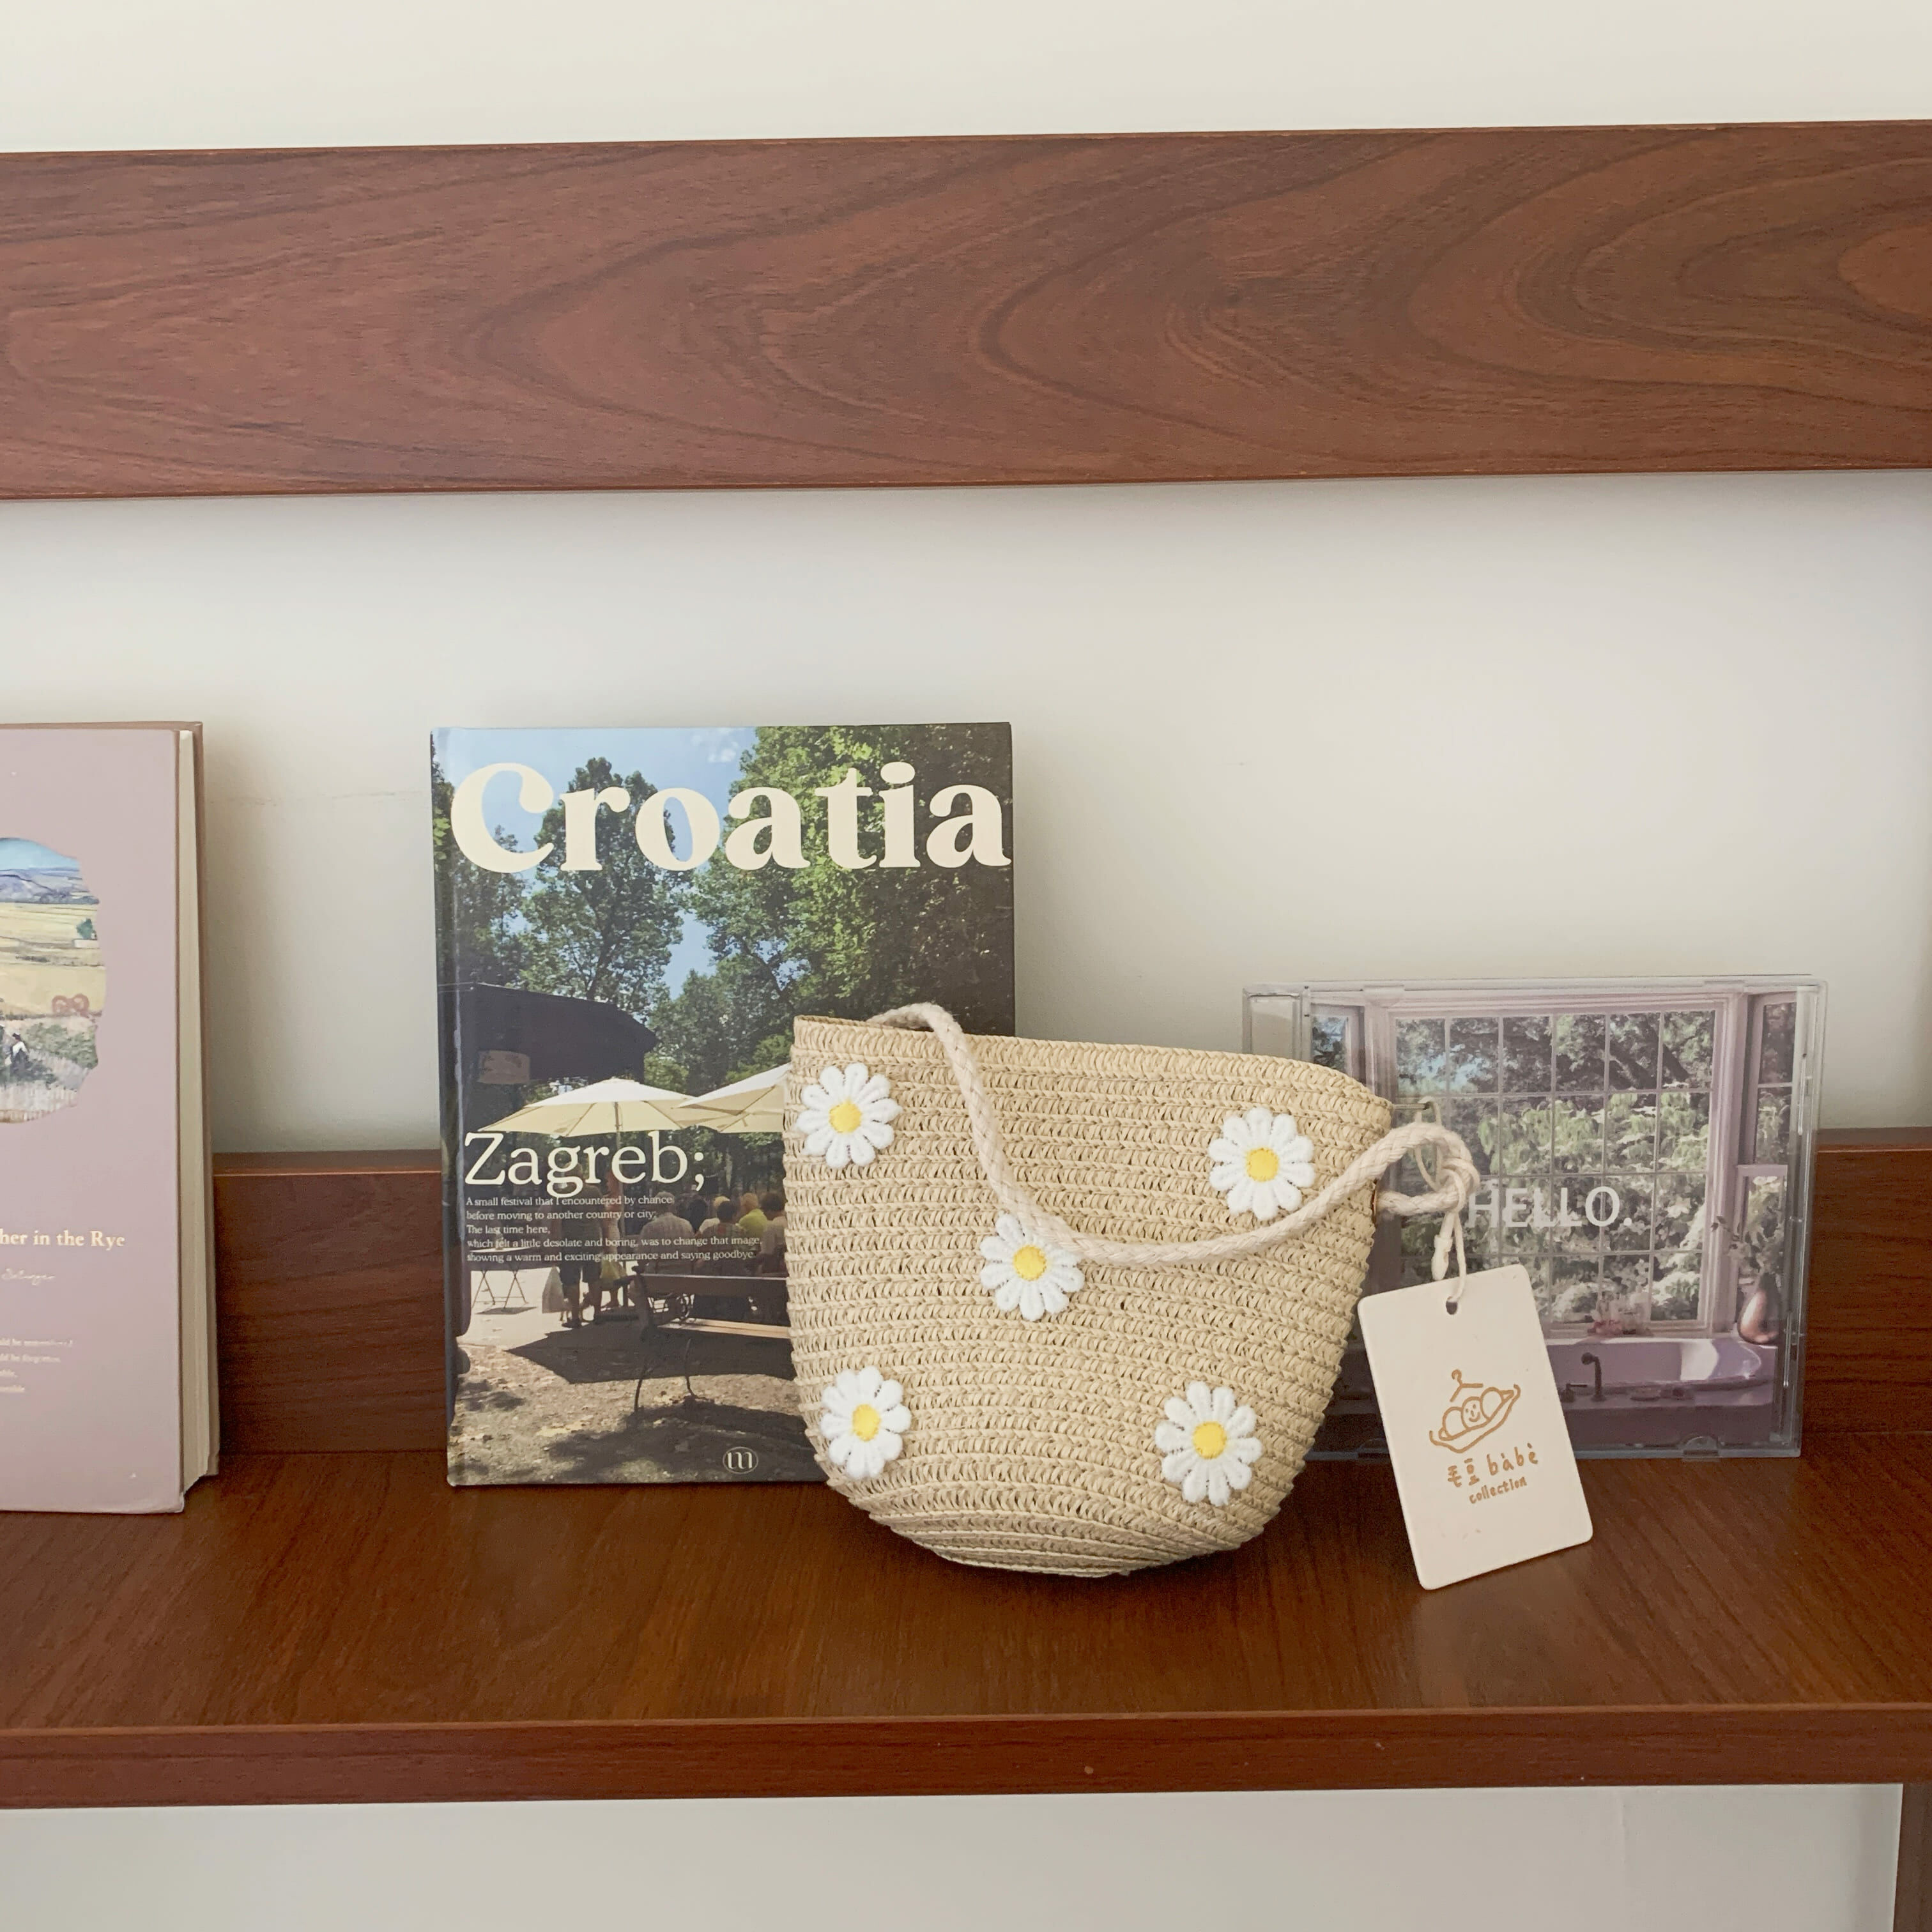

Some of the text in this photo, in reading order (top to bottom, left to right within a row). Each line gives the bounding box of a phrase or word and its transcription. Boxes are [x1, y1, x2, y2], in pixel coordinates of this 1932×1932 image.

[450, 762, 1012, 874] Croatia
[464, 1130, 705, 1199] Zagreb;
[466, 1197, 473, 1206] A
[474, 1197, 498, 1206] small
[501, 1197, 532, 1206] festival
[535, 1197, 553, 1206] that
[562, 1196, 622, 1206] encountered
[624, 1195, 636, 1206] by
[638, 1195, 673, 1204] chance
[1468, 1186, 1632, 1228] HELLO.
[466, 1211, 494, 1220] before
[497, 1211, 532, 1222] moving
[535, 1211, 544, 1220] to
[547, 1211, 583, 1220] another
[586, 1211, 621, 1221] country
[466, 1224, 482, 1234] The
[486, 1225, 501, 1234] last
[503, 1225, 525, 1234] time
[33, 1230, 50, 1245] in
[56, 1230, 84, 1246] the
[91, 1230, 126, 1251] Rye
[467, 1239, 493, 1248] which
[495, 1239, 510, 1248] felt
[521, 1238, 540, 1248] little
[543, 1238, 582, 1247] desolate
[585, 1238, 603, 1247] and
[661, 1237, 671, 1246] to
[673, 1236, 708, 1247] change
[710, 1236, 728, 1245] that
[467, 1253, 504, 1264] showing
[544, 1252, 563, 1262] and
[564, 1252, 601, 1263] exciting
[602, 1252, 659, 1262] appearance
[661, 1250, 679, 1260] and
[681, 1250, 710, 1261] saying
[1469, 1476, 1528, 1504] collection
